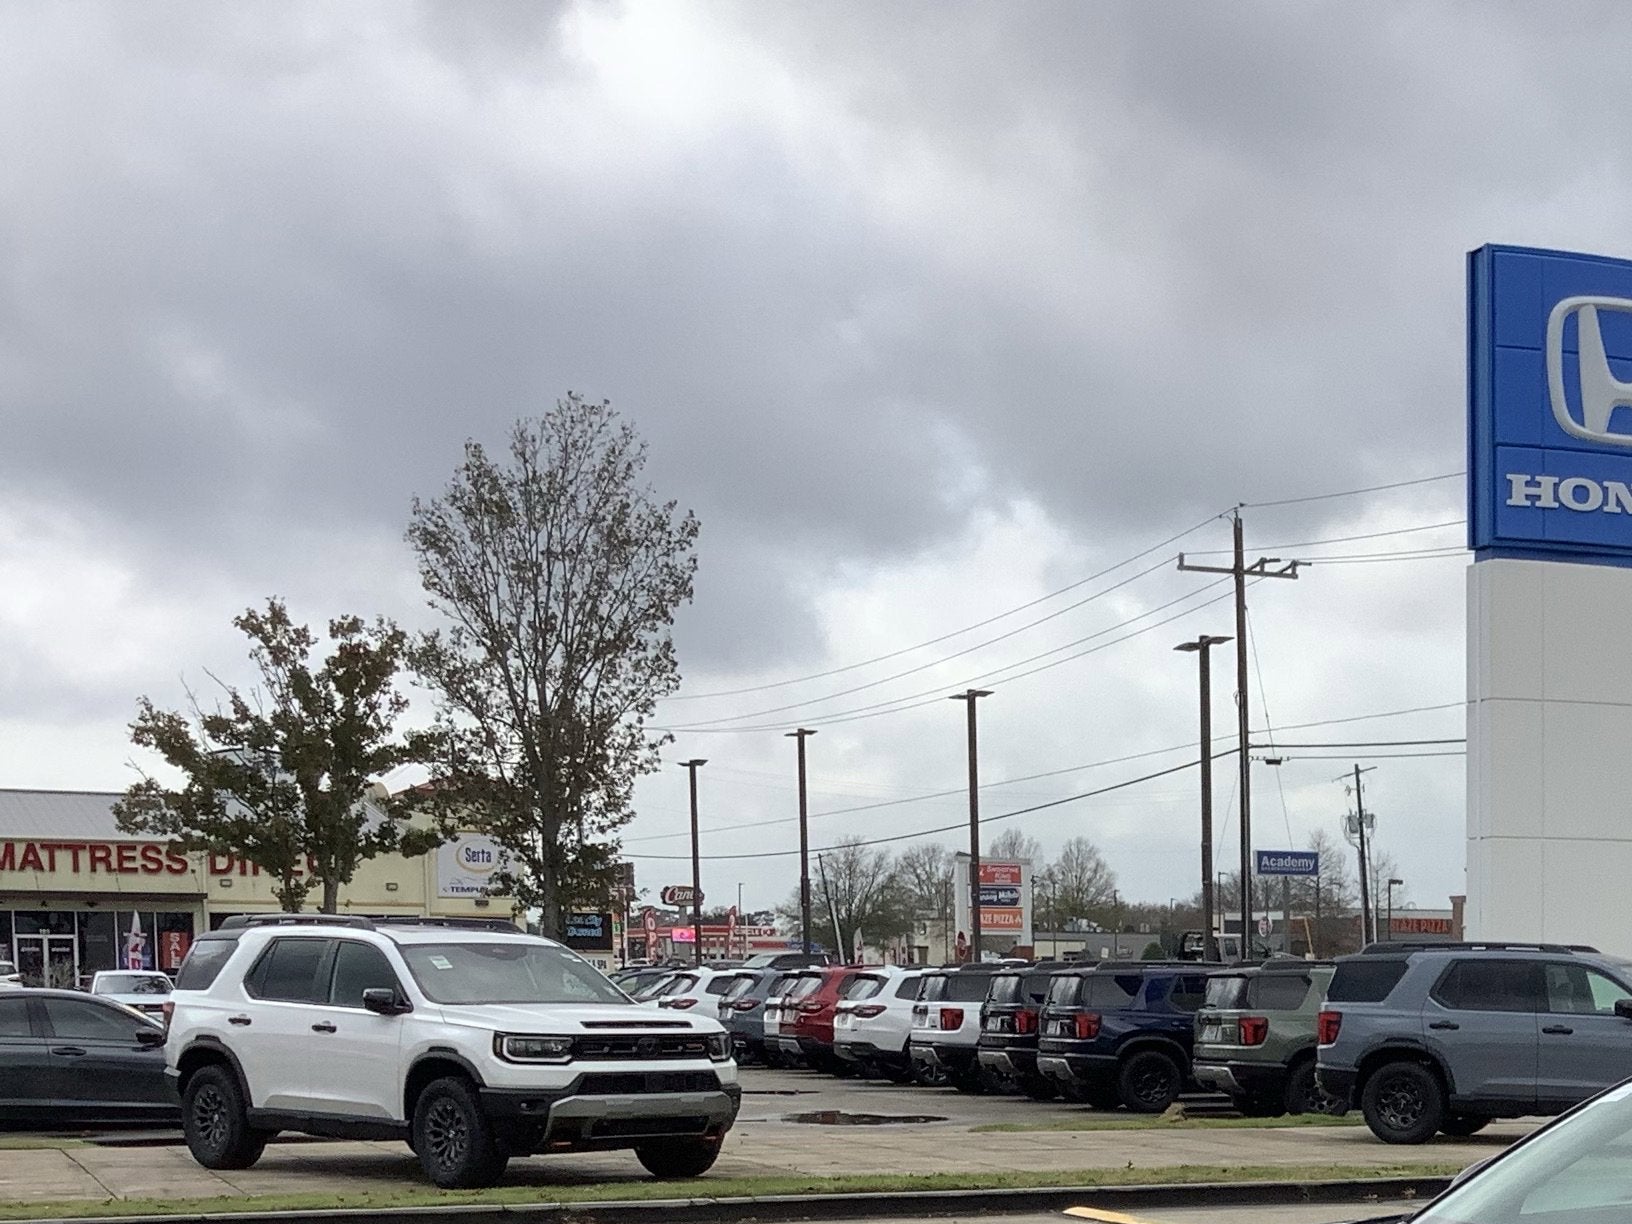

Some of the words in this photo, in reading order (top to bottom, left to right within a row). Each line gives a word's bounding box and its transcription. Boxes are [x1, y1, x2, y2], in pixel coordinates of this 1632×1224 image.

[465, 847, 492, 863] Serta
[1261, 855, 1315, 871] Academy
[170, 932, 181, 968] SALE
